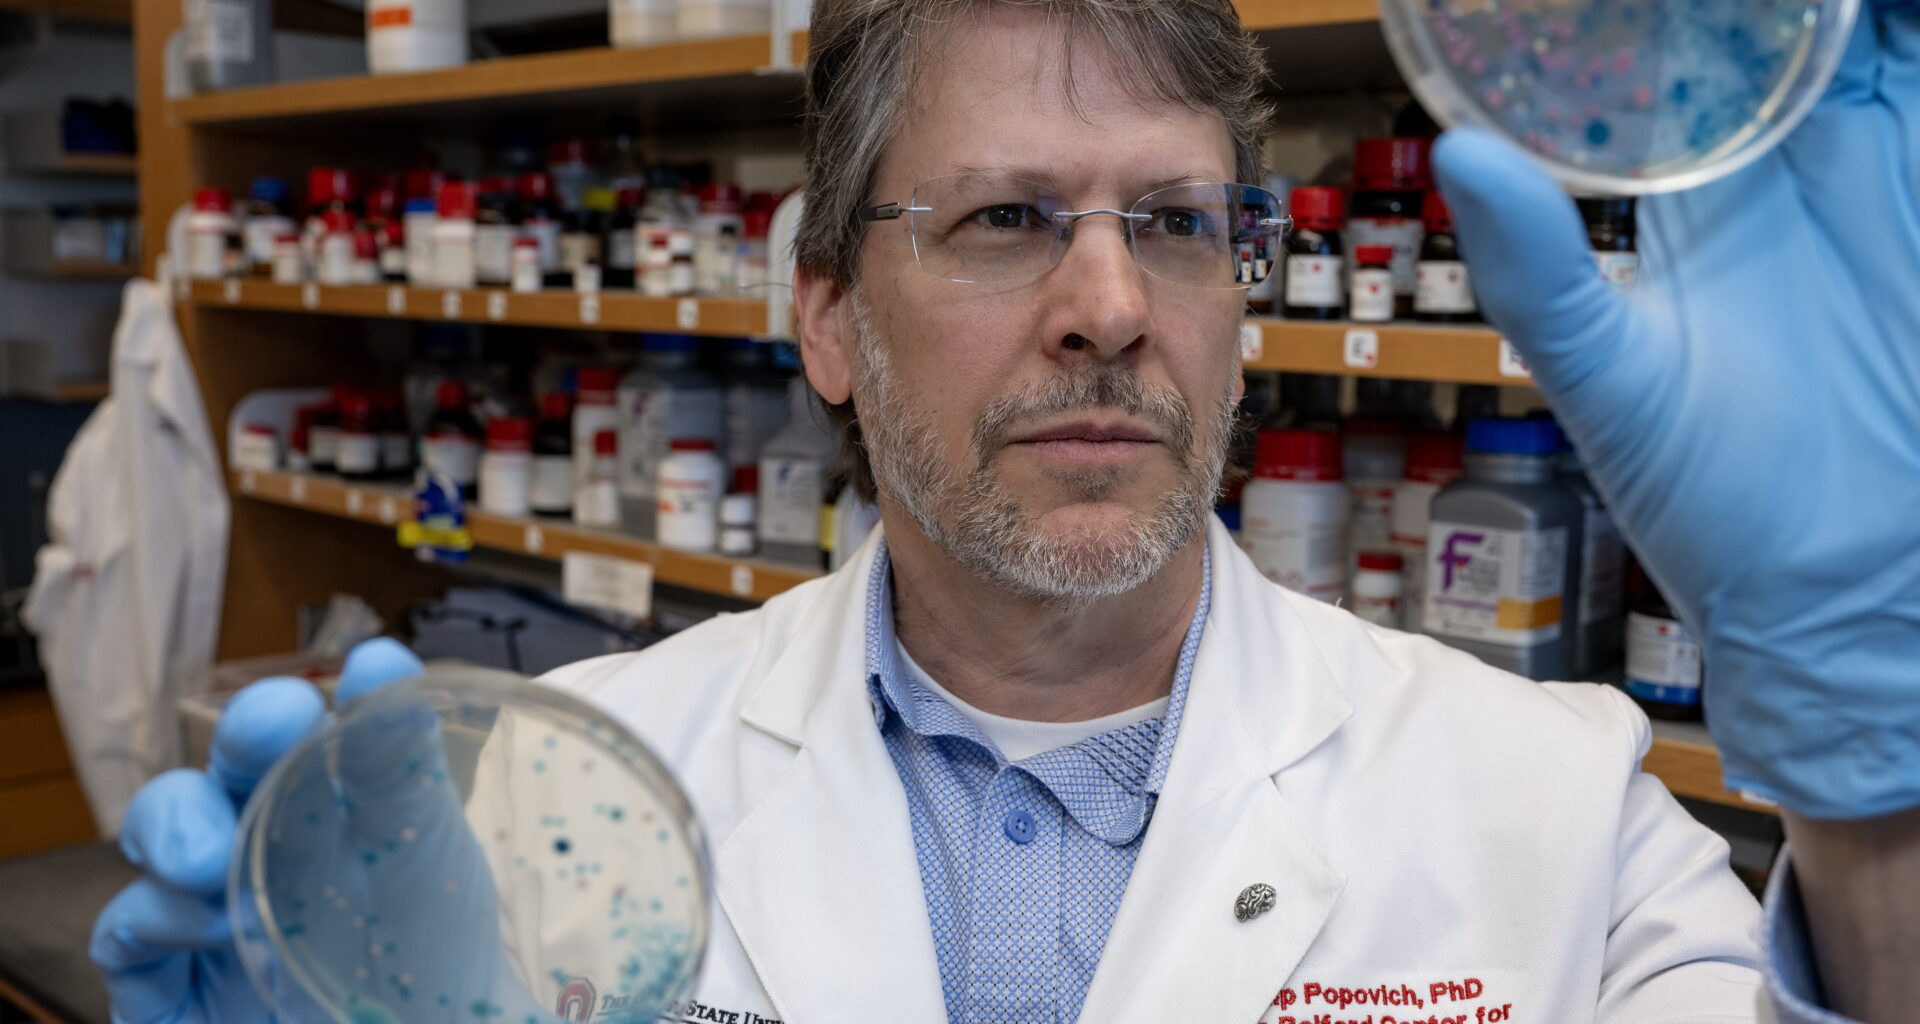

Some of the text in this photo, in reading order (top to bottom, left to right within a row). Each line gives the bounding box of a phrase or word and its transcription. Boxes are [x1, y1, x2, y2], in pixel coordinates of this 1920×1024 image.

[1303, 982, 1424, 1010] Popovich,
[1429, 977, 1484, 1005] PhD
[1476, 1003, 1513, 1024] for
